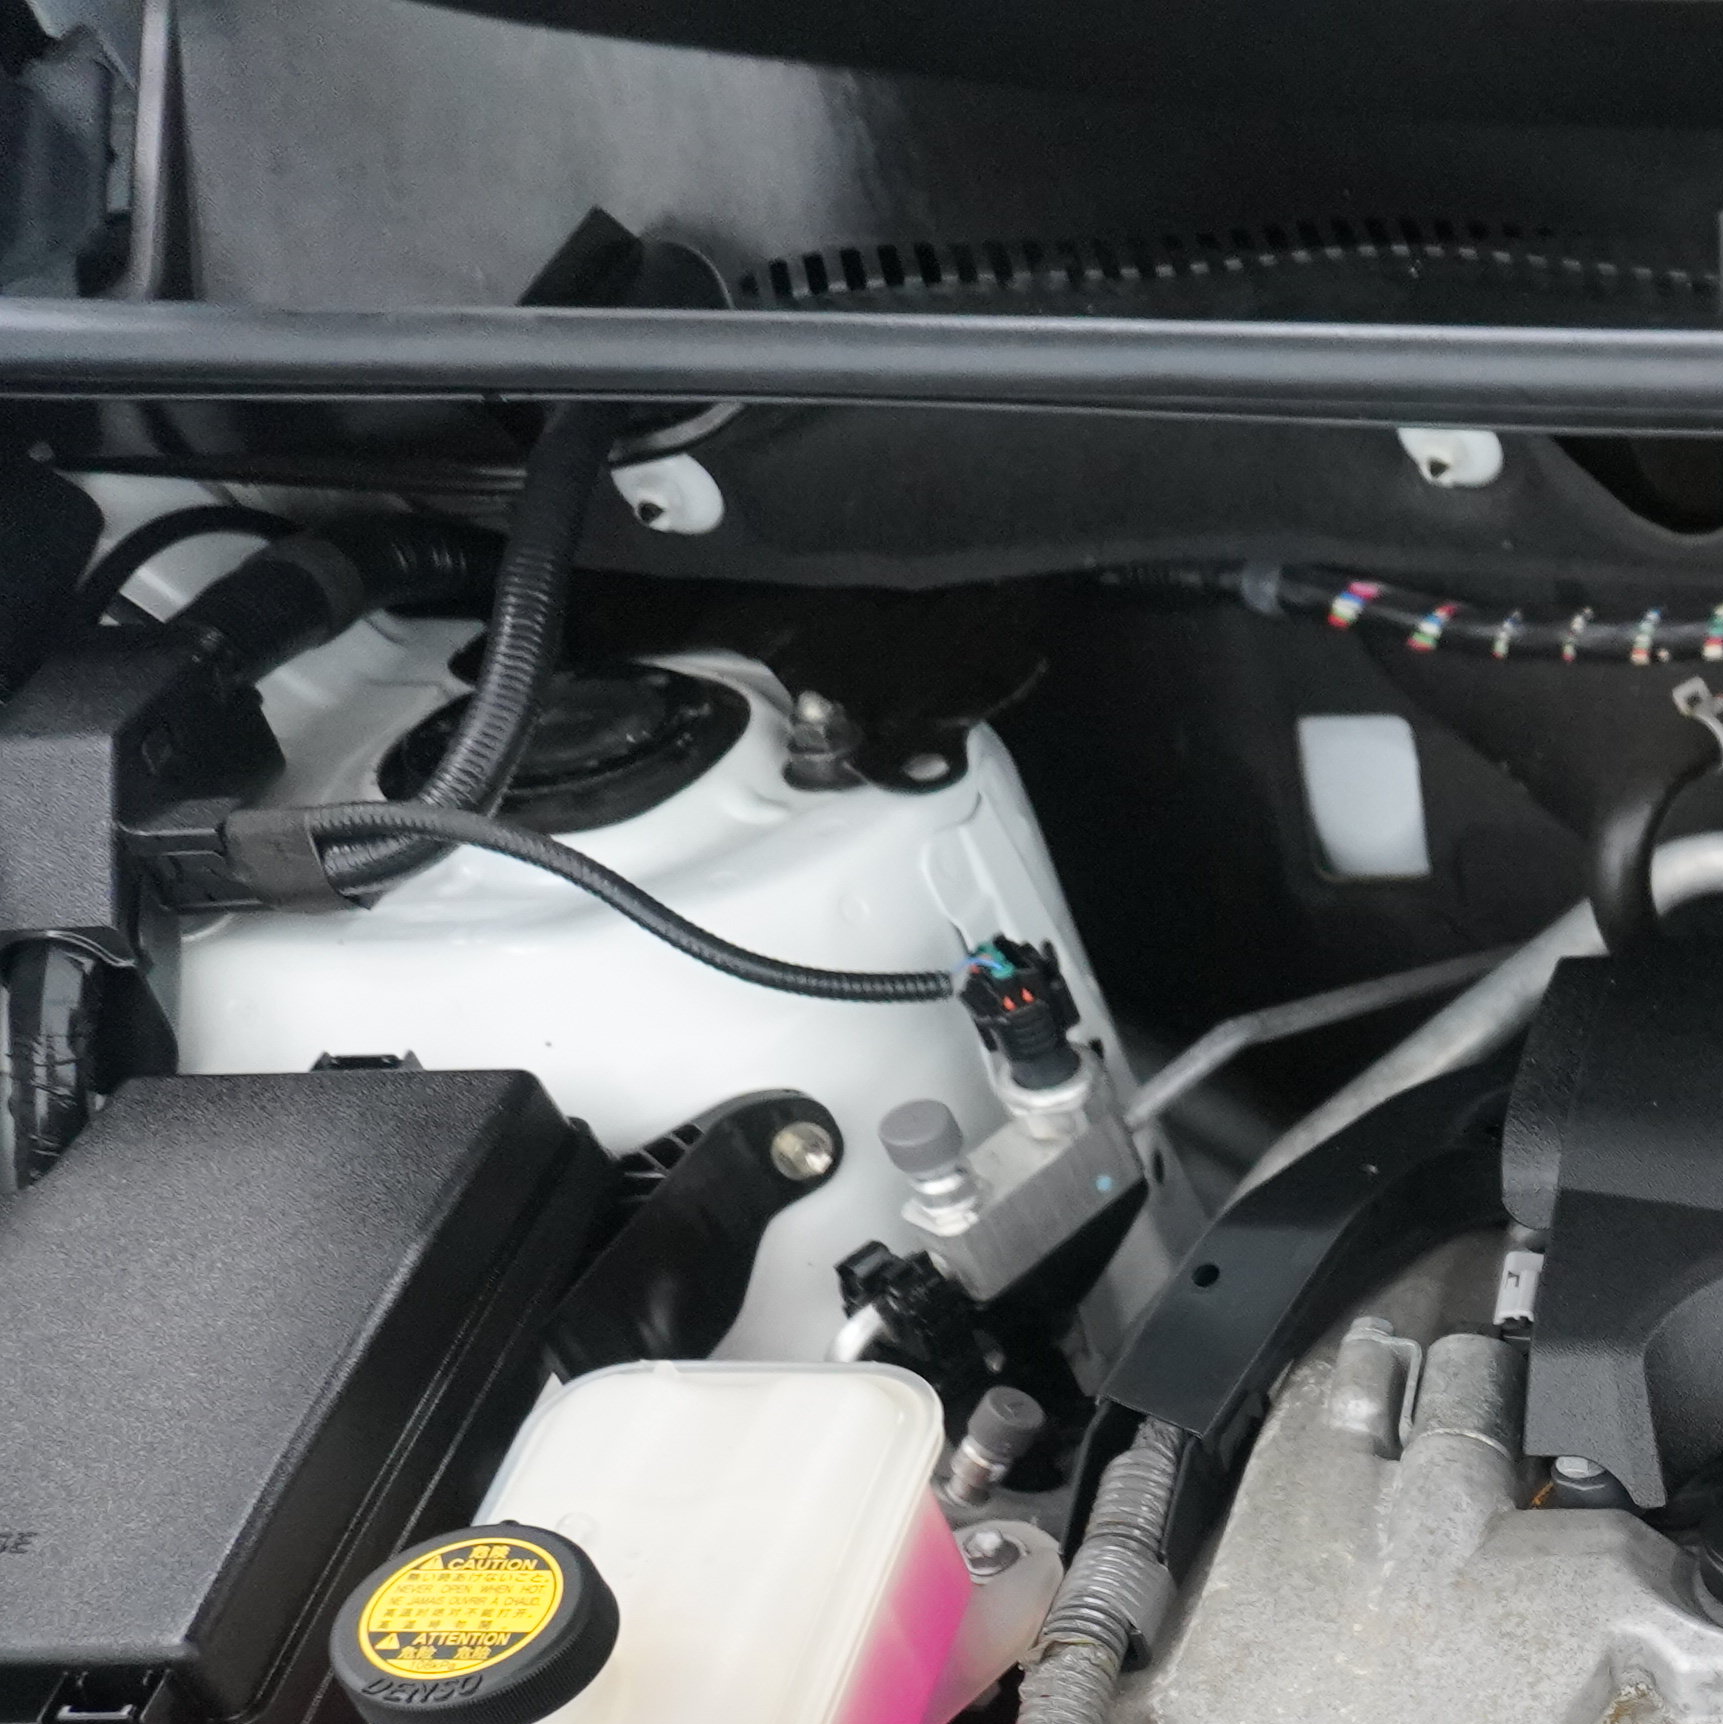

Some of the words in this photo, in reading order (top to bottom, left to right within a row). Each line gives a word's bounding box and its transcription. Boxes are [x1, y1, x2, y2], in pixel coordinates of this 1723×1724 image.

[447, 1558, 538, 1570] CAUTION
[395, 1584, 433, 1594] NEVER
[440, 1584, 471, 1594] OPEN
[480, 1584, 512, 1593] WHEN
[412, 1632, 512, 1646] ATTENTION
[361, 1674, 483, 1704] DENSO
